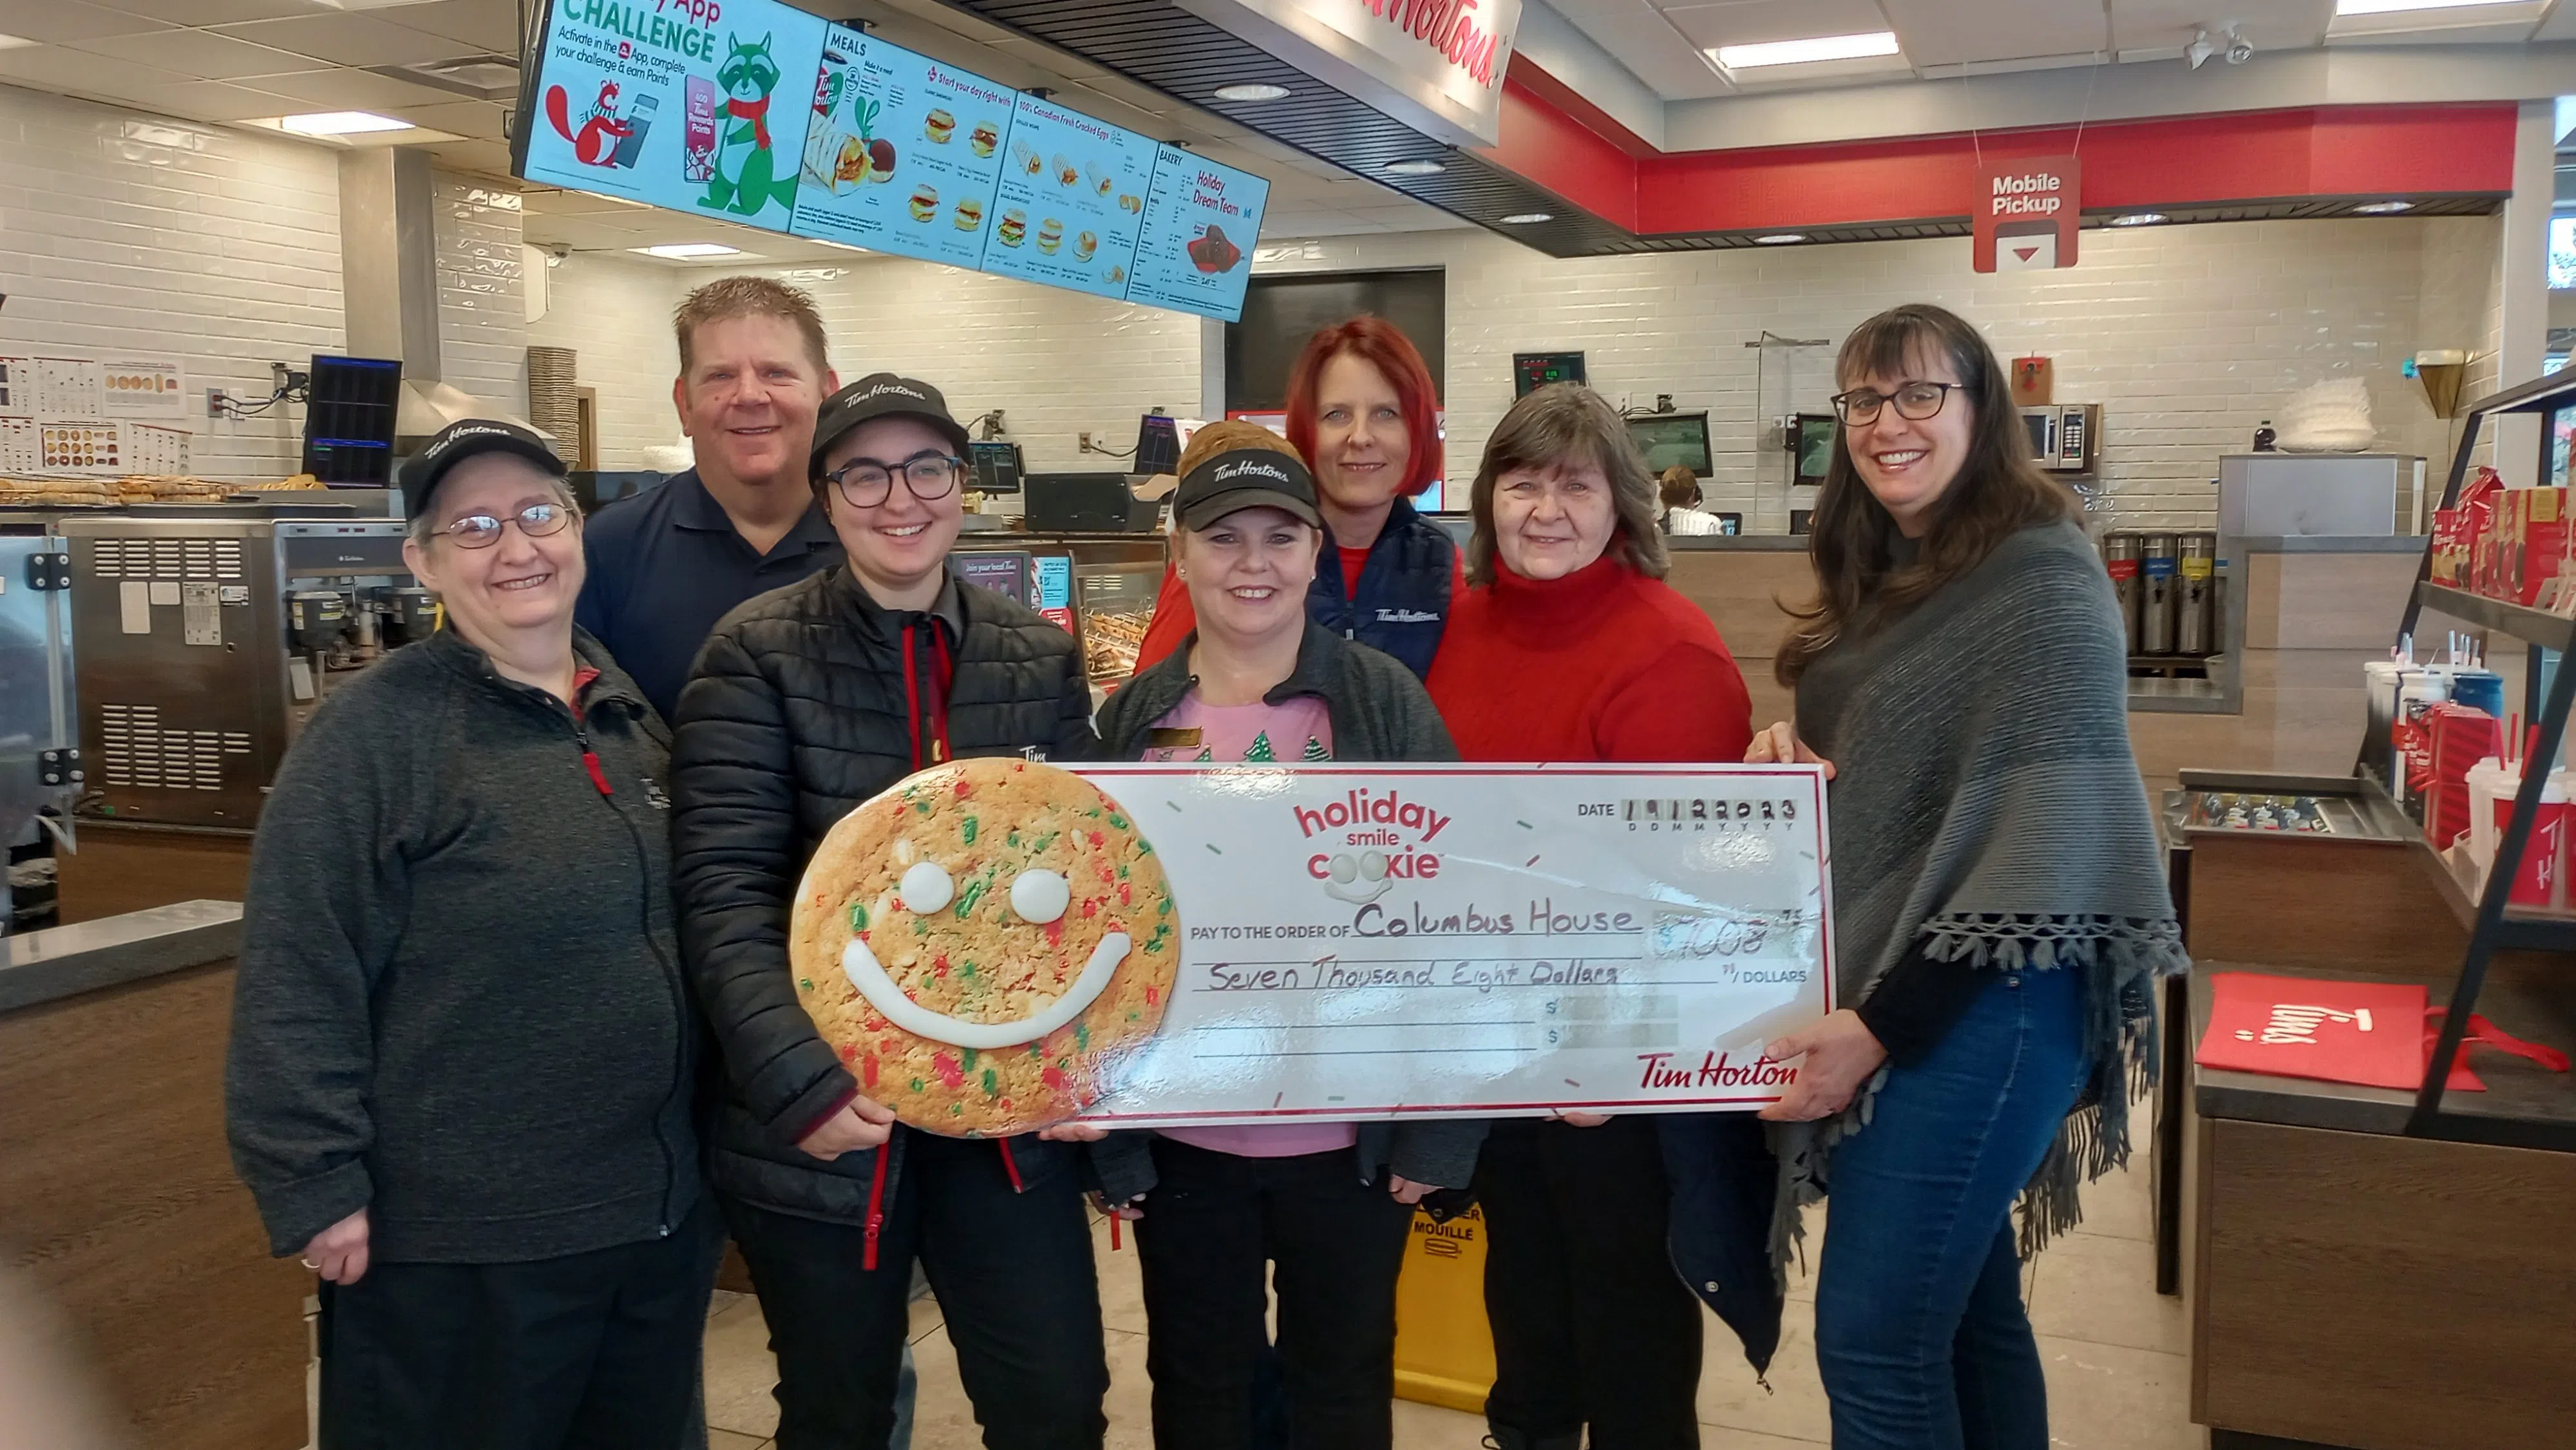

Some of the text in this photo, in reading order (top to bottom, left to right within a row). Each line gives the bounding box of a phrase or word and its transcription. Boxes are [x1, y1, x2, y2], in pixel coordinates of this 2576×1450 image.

[564, 0, 716, 63] CHALLENGE
[830, 33, 867, 56] MEALS
[558, 26, 685, 74] Activate in the App, complete
[555, 44, 669, 86] your challenge & earn Points
[938, 73, 954, 87] Start
[955, 81, 970, 92] your
[970, 85, 983, 99] day
[982, 90, 998, 102] right
[1033, 106, 1060, 124] Canadian
[1059, 115, 1075, 127] Fresh
[1096, 128, 1110, 141] Eggs
[1159, 149, 1183, 166] BAKERY
[1197, 170, 1226, 196] Holiday
[1993, 173, 2061, 196] Mobile
[1193, 189, 1239, 216] Dream Team
[1993, 195, 2061, 216] Pickup
[844, 383, 926, 408] Tim Hortons
[424, 426, 512, 460] Tim Hortons
[1214, 460, 1289, 482] Tim Hortons
[966, 564, 977, 573] Join
[1019, 745, 1046, 763] Tim
[1293, 787, 1452, 843] holiday
[1578, 804, 1615, 817] DATE
[1347, 828, 1400, 846] smile
[1307, 844, 1439, 884] cookie
[1354, 897, 1643, 938] Columbus House
[1191, 925, 1350, 940] PAY TO THE ORDER OF
[1209, 954, 1620, 993] Seven Thousand Eight Dollars
[1743, 970, 1807, 983] DOLLARS
[1637, 1051, 1691, 1089] Tim
